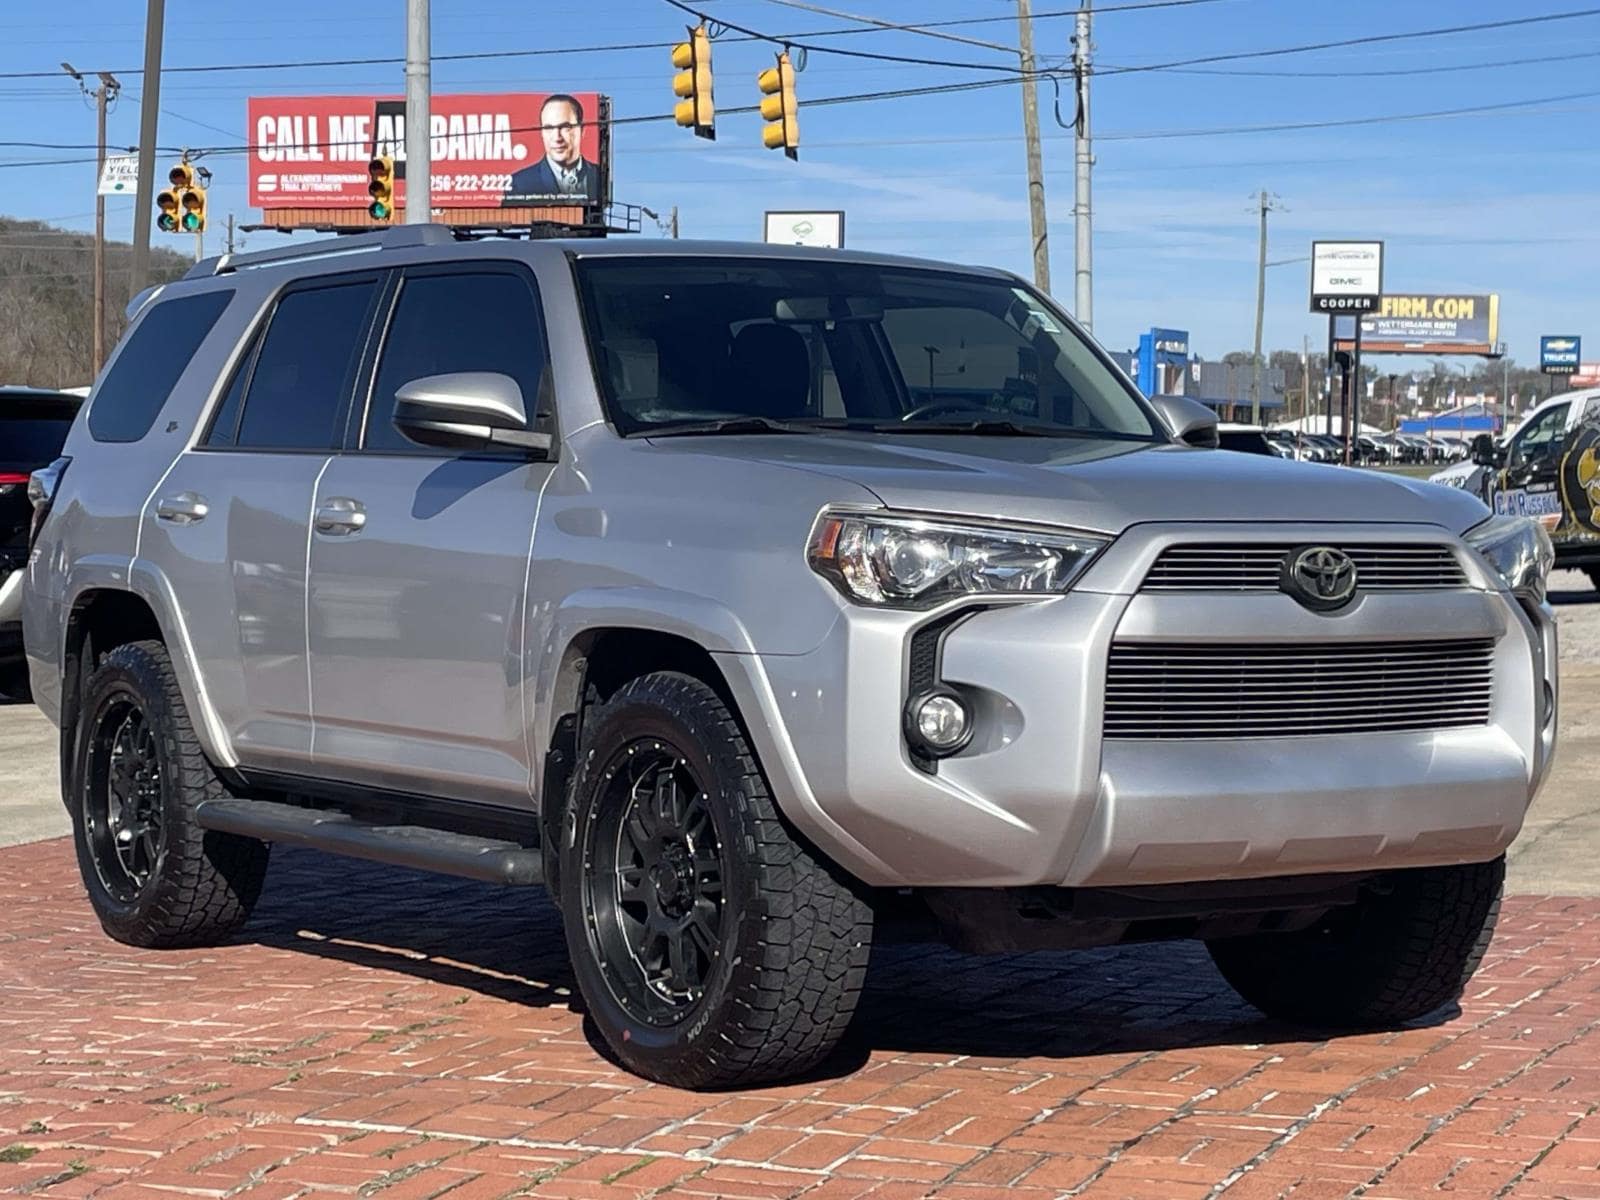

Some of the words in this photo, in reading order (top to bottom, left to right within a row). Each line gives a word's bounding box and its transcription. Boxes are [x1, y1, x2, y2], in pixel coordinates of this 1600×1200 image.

[257, 115, 324, 162] CALL
[328, 115, 372, 162] ME
[373, 113, 528, 162] ALBAMA.
[1329, 278, 1362, 286] GMC
[1320, 298, 1371, 309] COOPER
